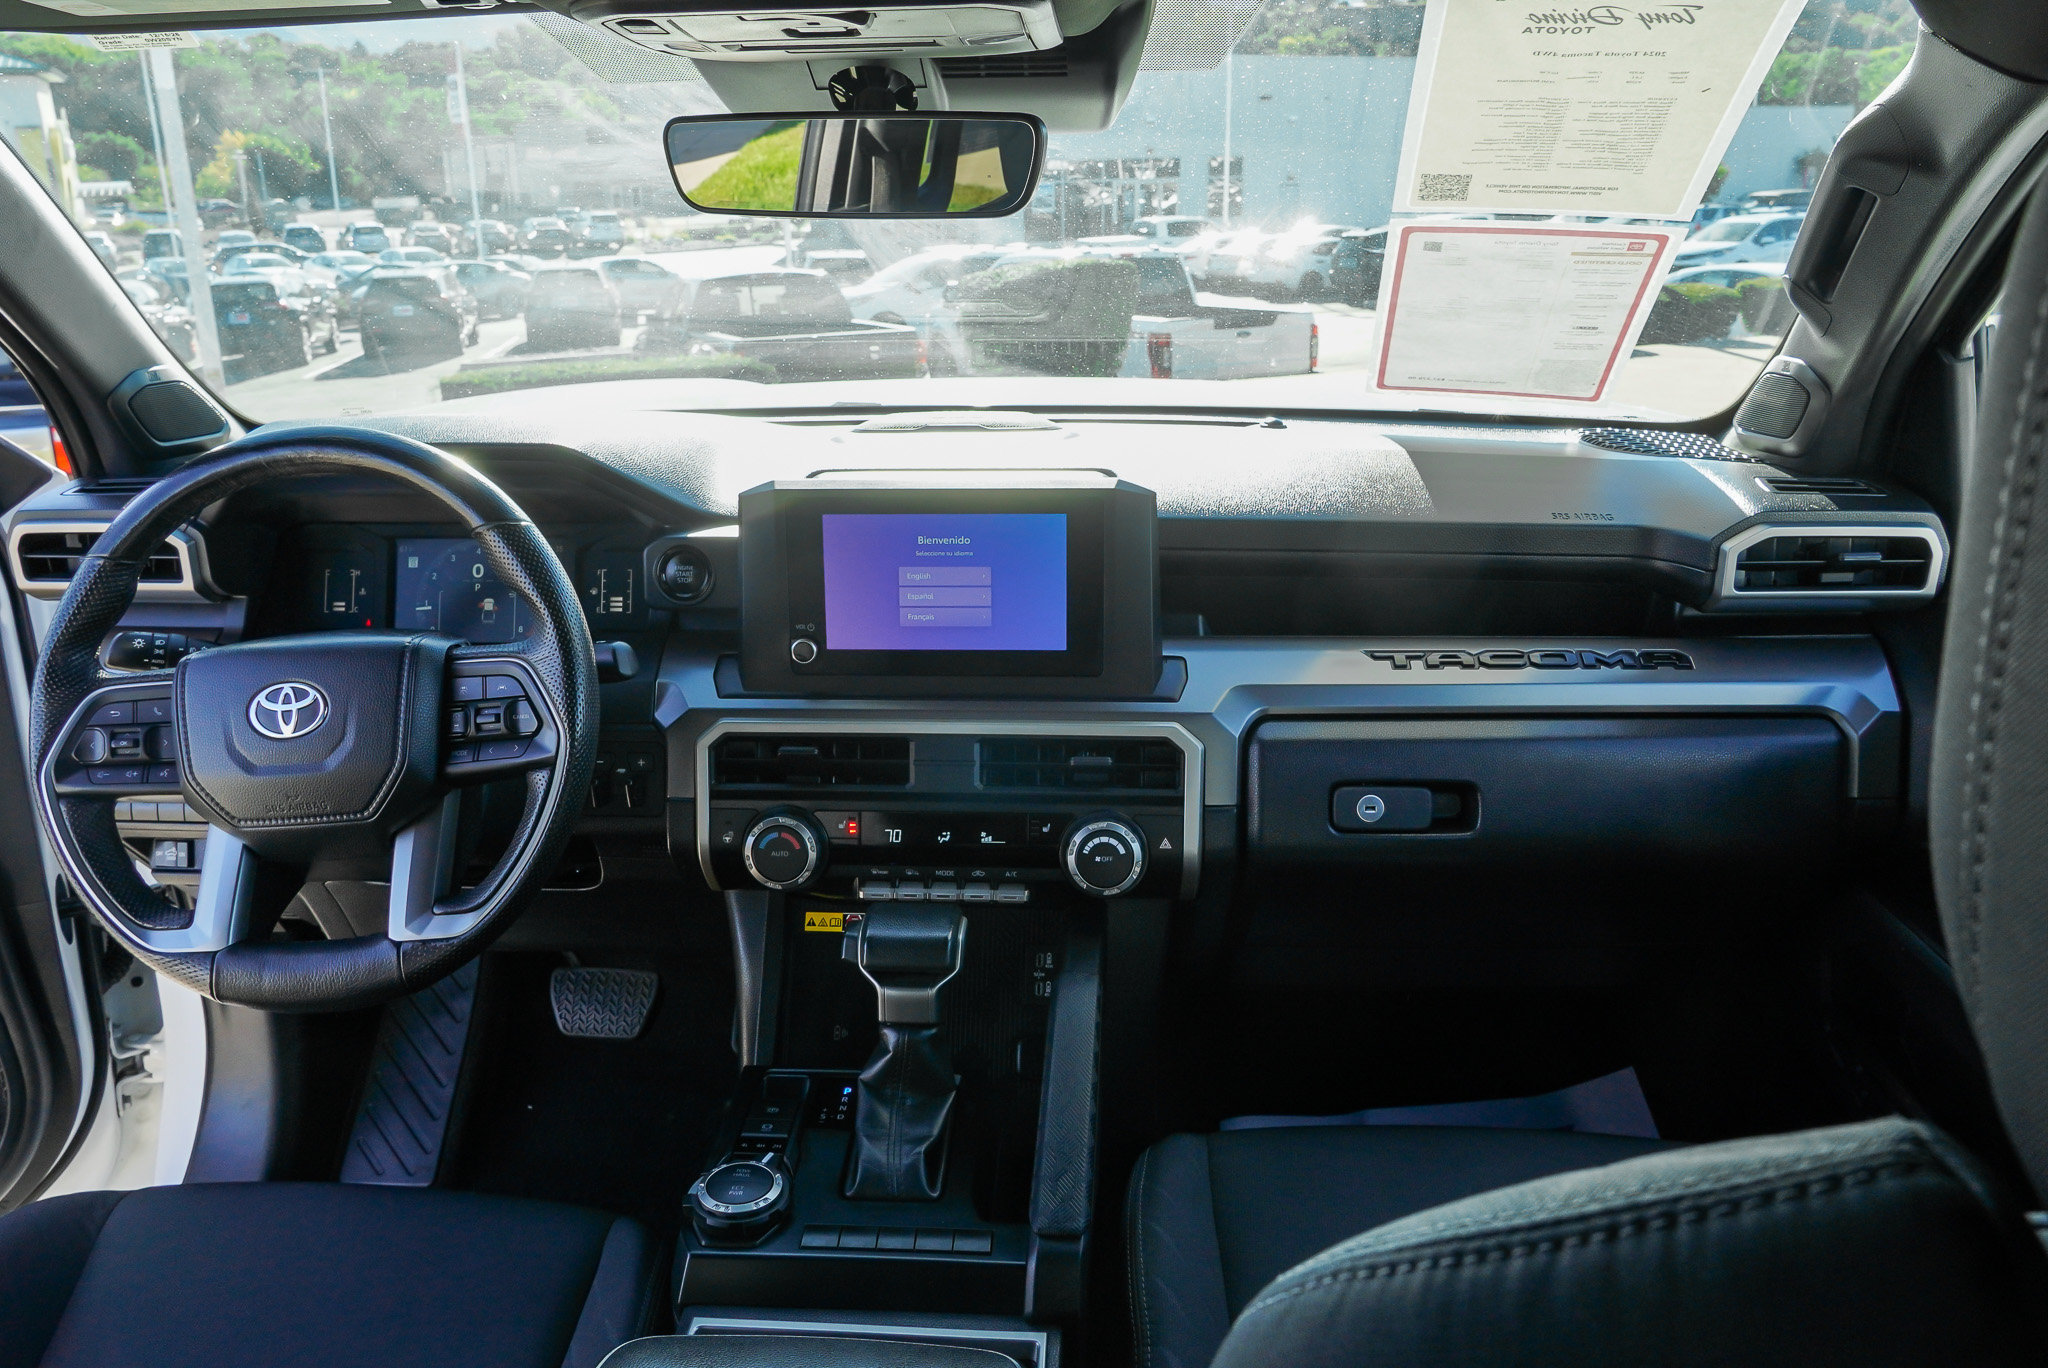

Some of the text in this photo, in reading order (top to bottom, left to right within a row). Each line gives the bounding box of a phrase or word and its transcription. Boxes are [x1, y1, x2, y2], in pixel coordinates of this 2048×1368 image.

[1552, 512, 1615, 522] SRS AIRBAG
[917, 535, 971, 545] Bienvenido
[451, 554, 456, 562] 3
[472, 563, 485, 579] 0
[907, 573, 931, 581] English
[475, 583, 481, 592] P
[907, 592, 934, 601] Español
[907, 613, 935, 622] Français
[1360, 648, 1696, 670] TACOMA
[884, 829, 902, 843] 70
[1005, 870, 1018, 878] A/C
[843, 1086, 852, 1095] P
